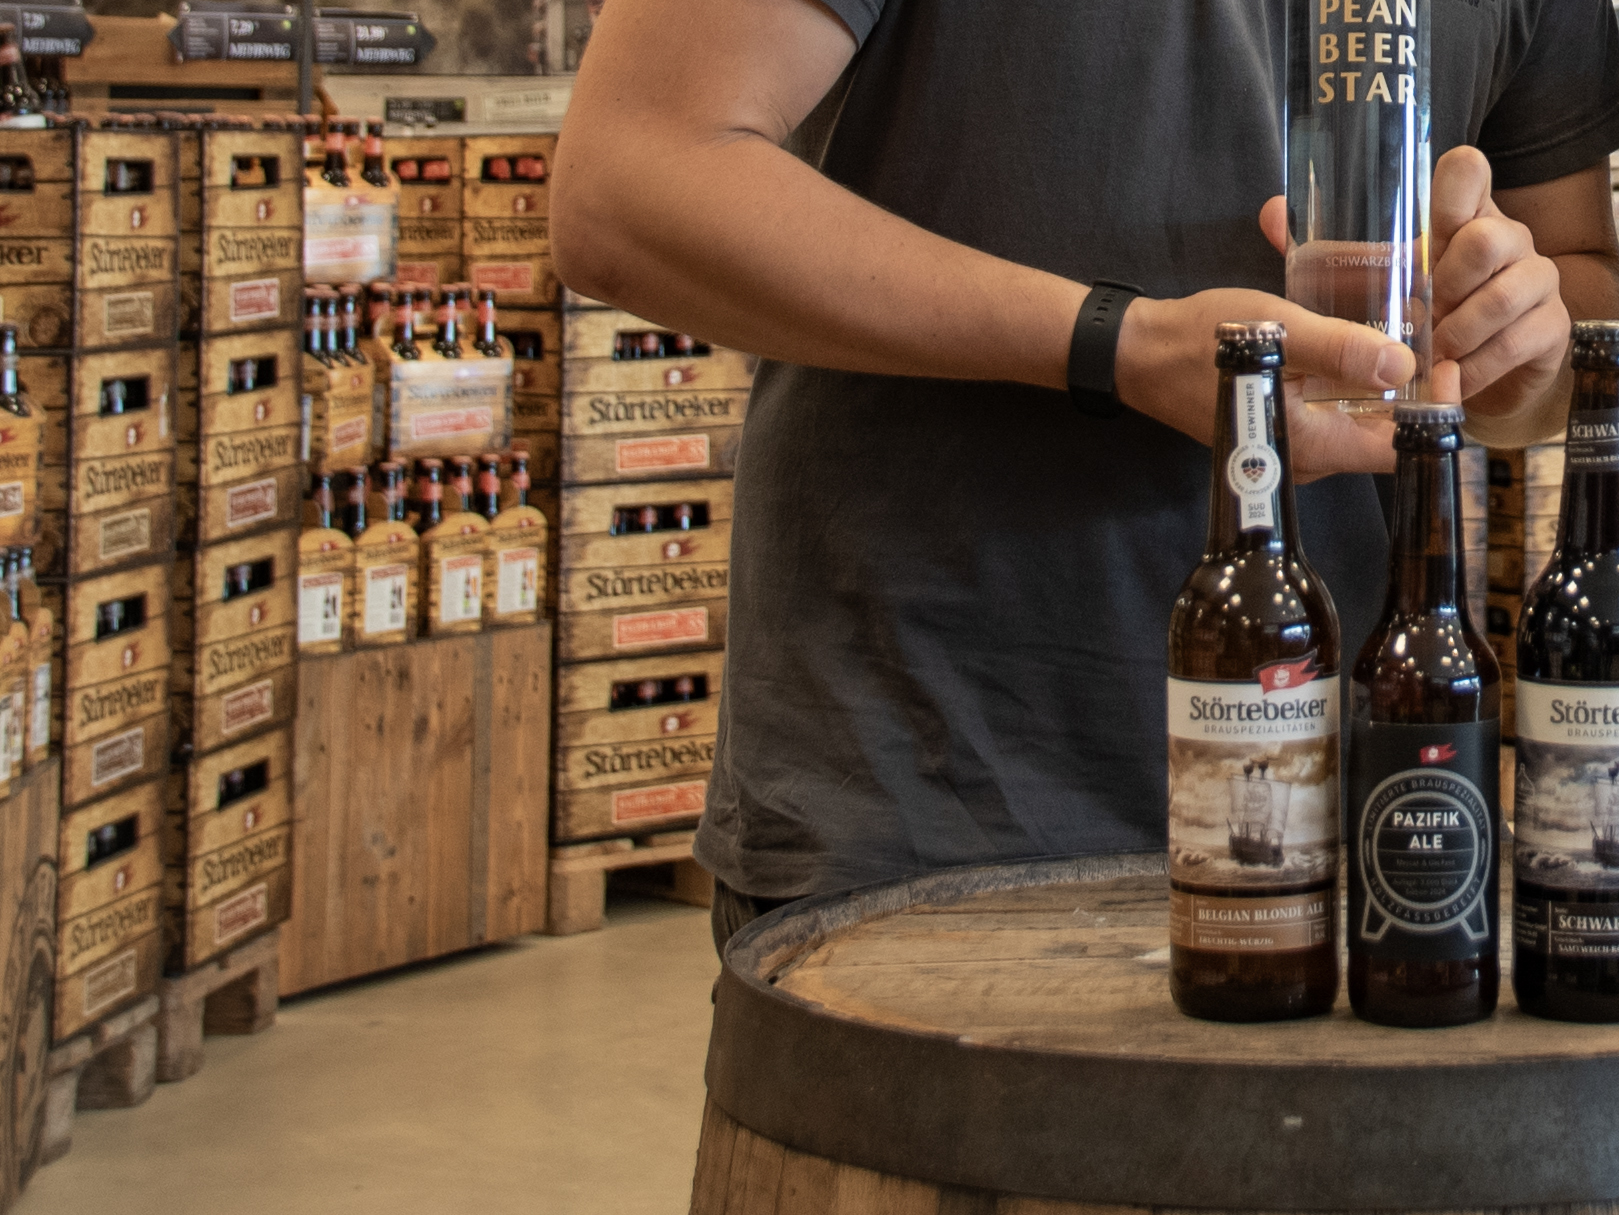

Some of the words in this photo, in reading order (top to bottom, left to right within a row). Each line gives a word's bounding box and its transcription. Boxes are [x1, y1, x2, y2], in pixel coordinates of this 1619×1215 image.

[1319, 32, 1417, 67] BEER
[1318, 71, 1417, 106] STAR
[588, 394, 733, 425] Störtebeker
[1245, 382, 1257, 440] GEWINNER
[1248, 511, 1266, 519] 2024
[1189, 695, 1328, 722] Störtebeker
[1393, 811, 1460, 827] PAZIFIK
[1409, 834, 1443, 849] ALE
[1198, 908, 1251, 922] BELGIAN
[1254, 905, 1301, 921] BLONDE
[1306, 901, 1324, 915] ALE
